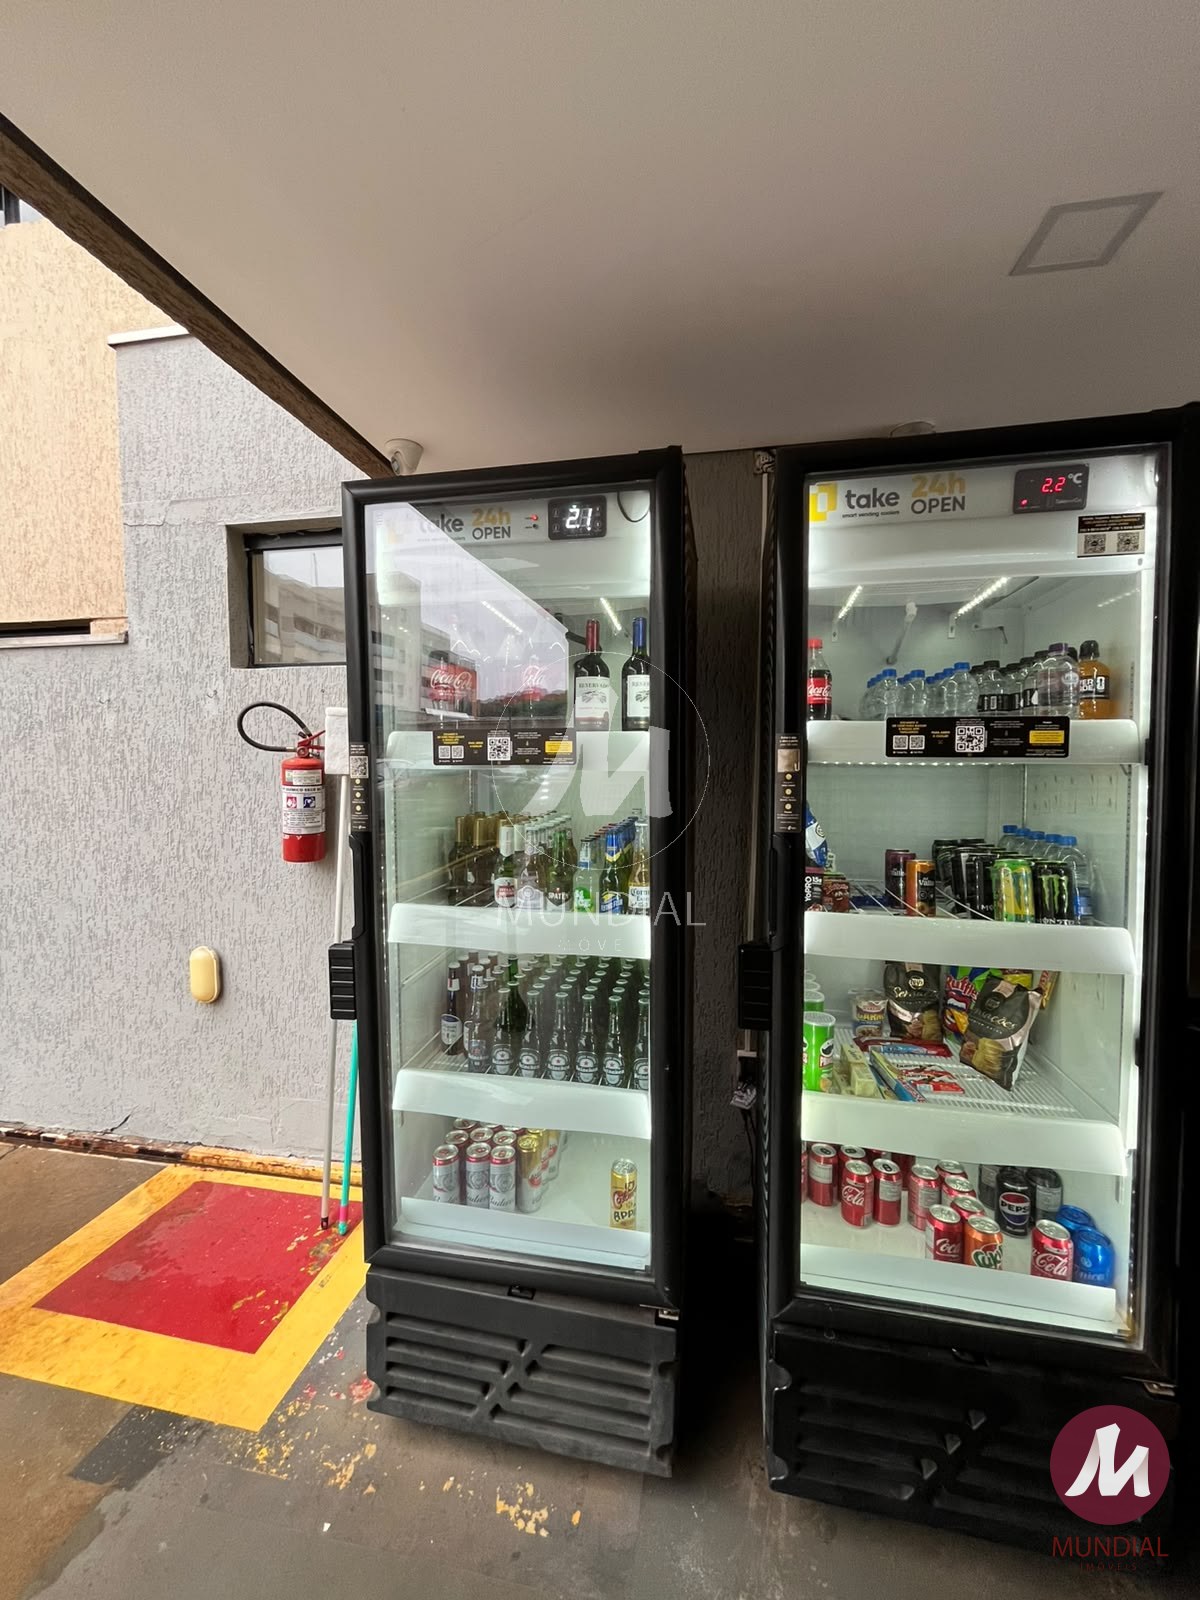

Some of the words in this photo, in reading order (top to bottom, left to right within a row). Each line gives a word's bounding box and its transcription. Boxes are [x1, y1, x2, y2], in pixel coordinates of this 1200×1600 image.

[844, 487, 900, 509] take
[911, 471, 966, 498] 24h
[910, 496, 966, 515] OPEN
[471, 506, 511, 527] 24h
[471, 526, 511, 541] OPEN
[804, 876, 812, 902] YoPRO
[841, 1185, 865, 1206] Cola
